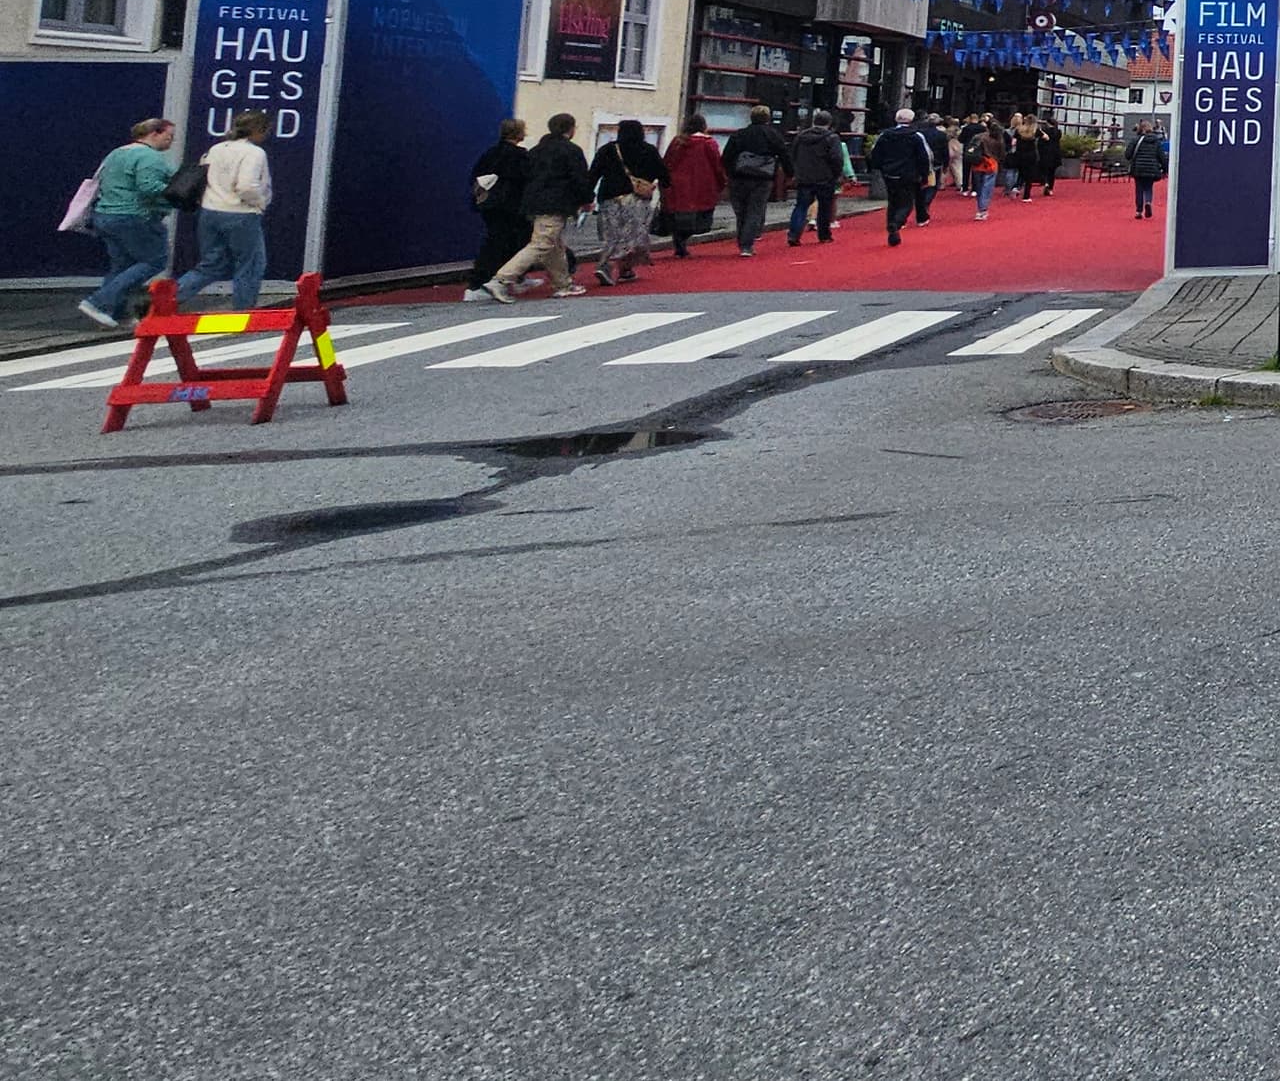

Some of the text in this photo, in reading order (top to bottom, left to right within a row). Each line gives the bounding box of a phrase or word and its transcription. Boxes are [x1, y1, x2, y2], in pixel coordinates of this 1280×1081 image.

[218, 5, 310, 22] FESTIVAL
[1199, 1, 1266, 28] FILM
[214, 26, 309, 63] HAU
[1198, 33, 1264, 45] FESTIVAL
[1196, 51, 1264, 80] HAU
[211, 69, 303, 101] GES
[1195, 87, 1262, 113] GES
[207, 107, 301, 139] UD
[1194, 119, 1262, 145] UND
